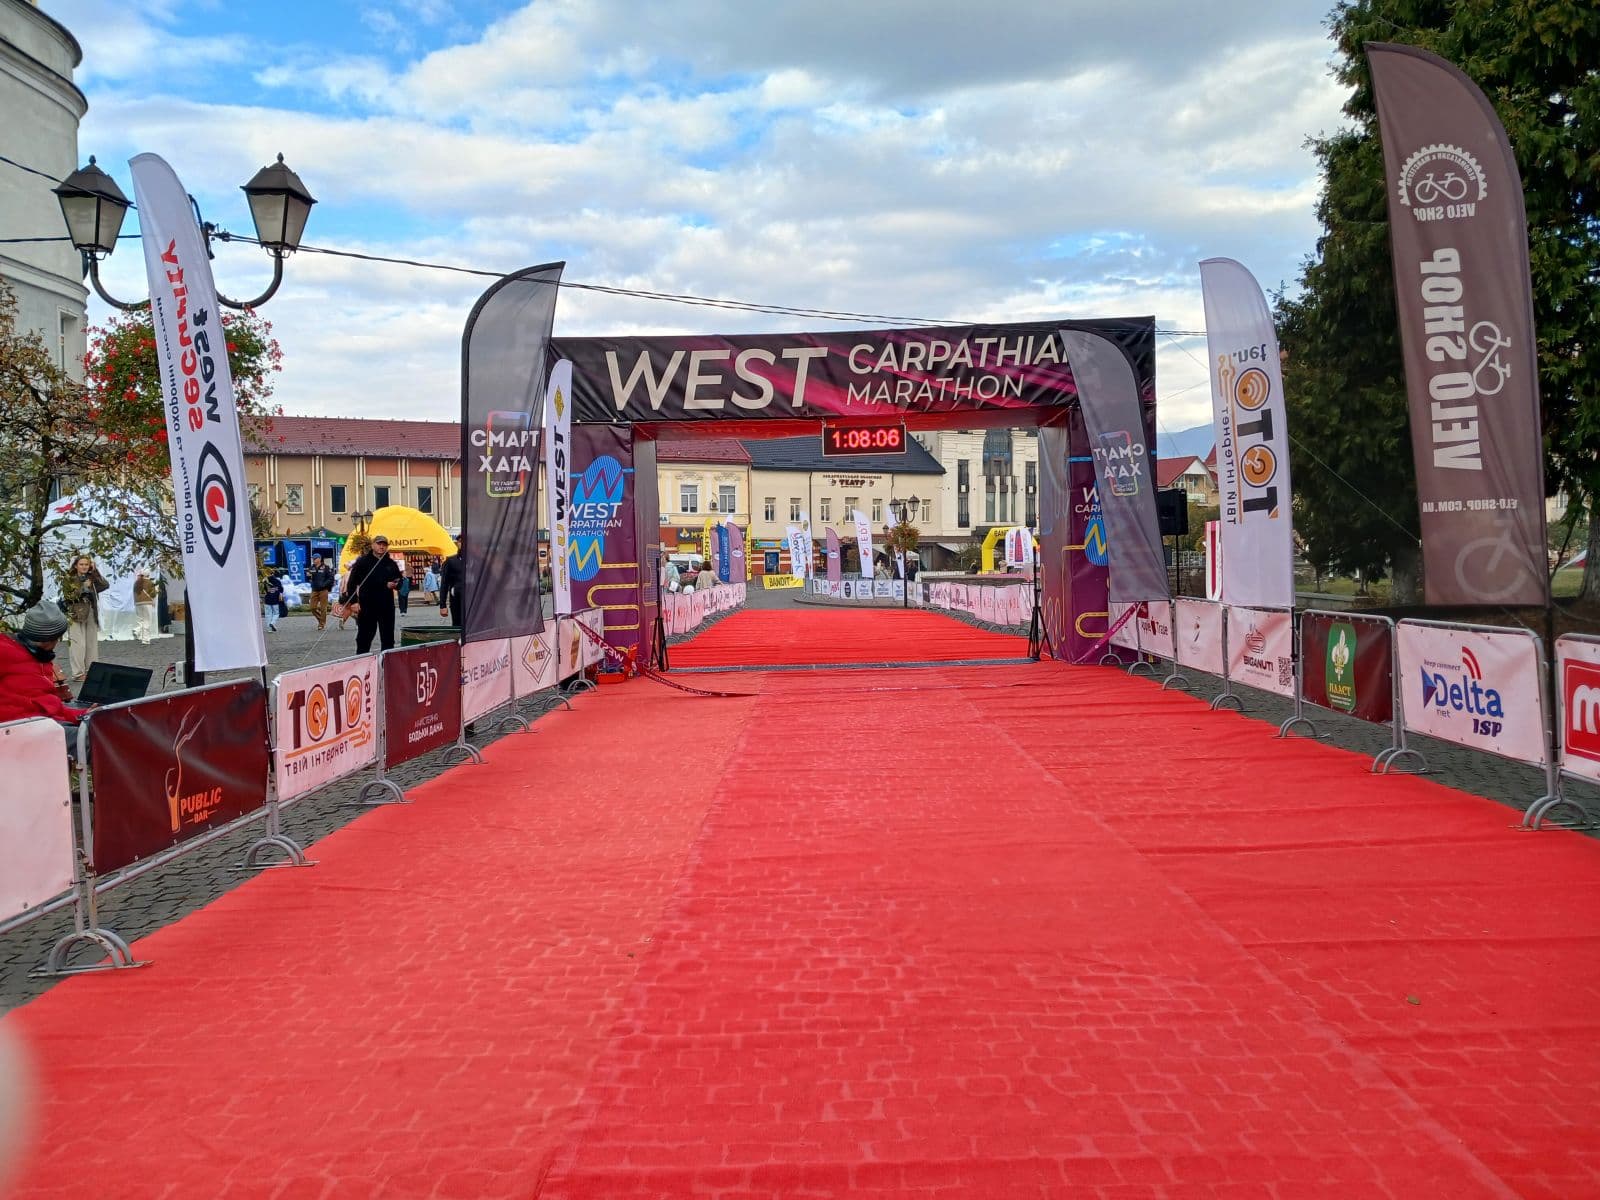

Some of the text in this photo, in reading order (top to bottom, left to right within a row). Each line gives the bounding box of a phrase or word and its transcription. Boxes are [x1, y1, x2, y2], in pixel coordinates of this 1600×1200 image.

[605, 346, 828, 411] WEST
[846, 374, 1024, 406] MARATHON
[470, 430, 540, 448] СМАРТ
[832, 429, 900, 448] 1:08:06
[478, 455, 532, 472] ХАТА
[569, 519, 622, 529] RPATHIAN
[387, 538, 418, 546] ANDIT
[769, 576, 791, 587] BANDIT
[462, 666, 479, 684] EYE
[1433, 673, 1504, 718] Delta
[1436, 709, 1451, 718] net
[1472, 718, 1503, 738] ISP
[285, 758, 308, 777] ТВІЙ
[180, 786, 222, 816] PUBLIC
[194, 811, 209, 824] BAR
